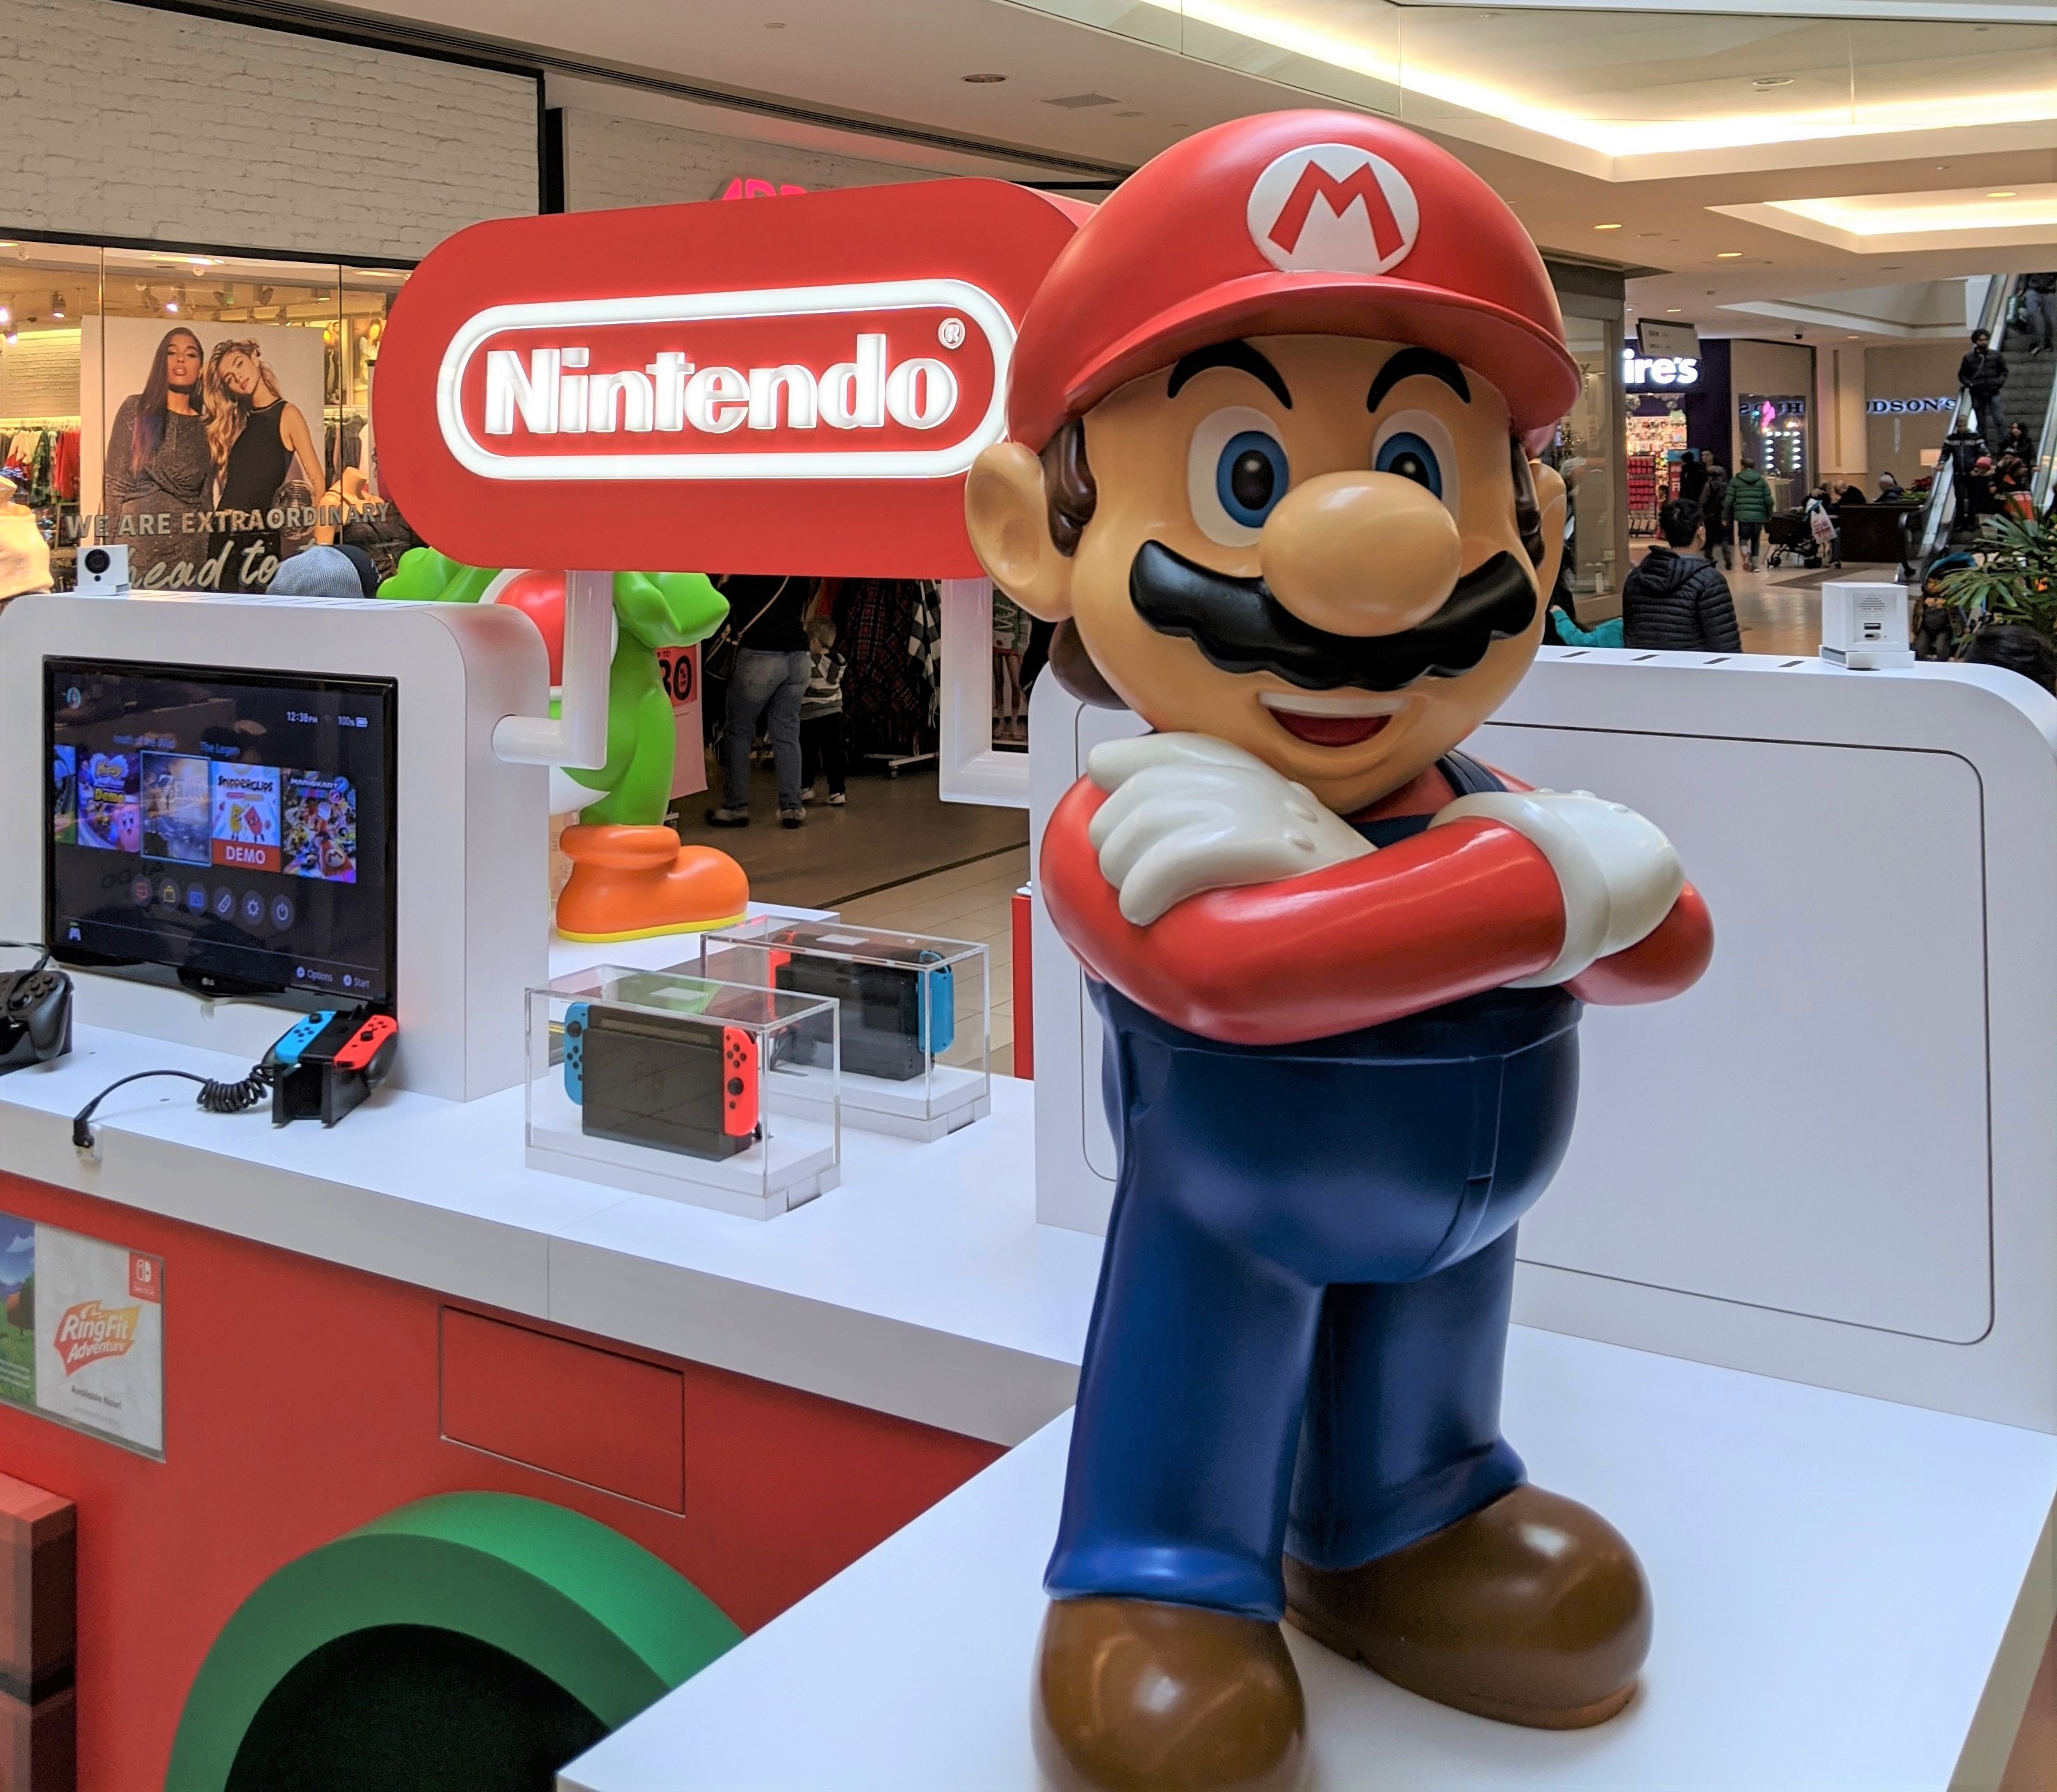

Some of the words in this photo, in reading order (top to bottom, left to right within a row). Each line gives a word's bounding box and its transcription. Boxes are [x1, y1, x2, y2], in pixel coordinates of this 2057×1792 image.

[1268, 159, 1405, 261] M
[1866, 398, 1957, 412] DSON'S
[65, 514, 109, 538] WE
[117, 512, 172, 536] ARE
[181, 502, 391, 534] EXTRAORDINARY
[240, 539, 279, 585] to
[225, 845, 266, 865] DEMO
[66, 1340, 127, 1364] Adventure
